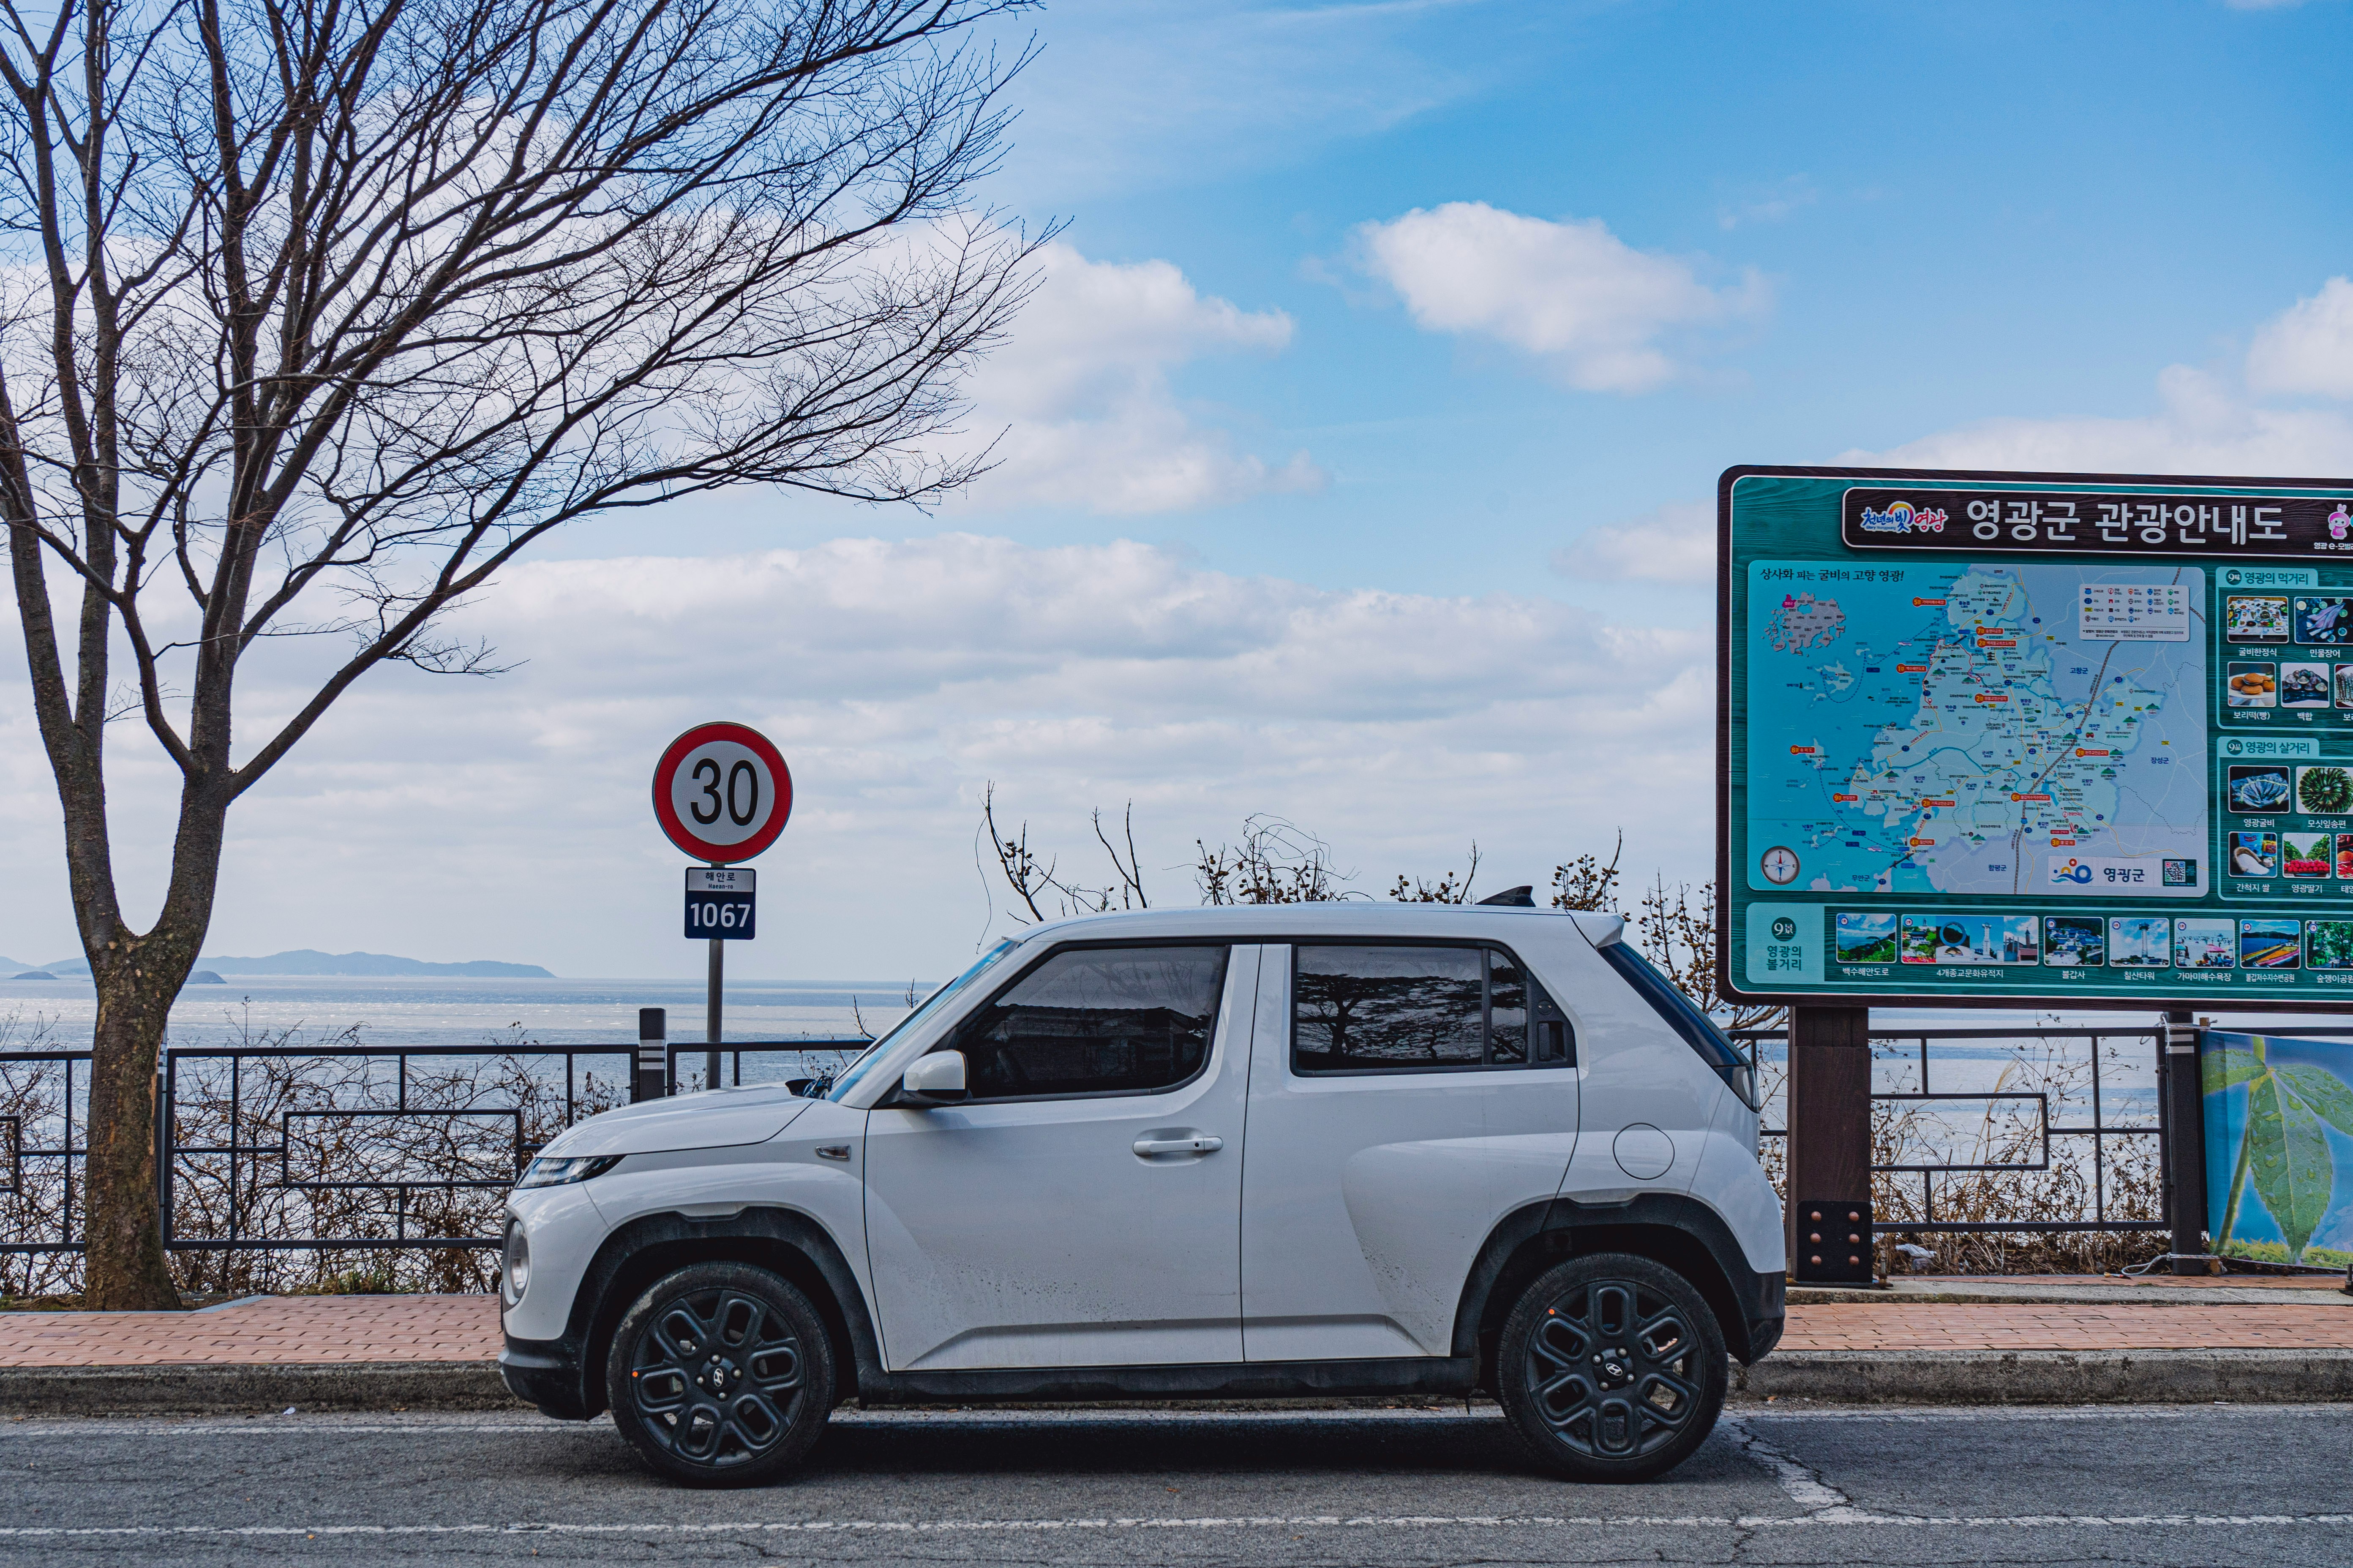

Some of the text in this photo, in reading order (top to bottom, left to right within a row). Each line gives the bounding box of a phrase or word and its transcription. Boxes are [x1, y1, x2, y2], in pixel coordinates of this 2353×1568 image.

[1862, 509, 1947, 531] 천년의 빛 영광
[1967, 501, 2287, 545] 영광군 관광안내도
[1760, 568, 1904, 582] 상사화 피는 굴비의 고향 영광!
[2244, 572, 2309, 585] 영광의 먹거리
[2238, 648, 2277, 657] 굴비한정식
[2309, 649, 2340, 658] 민물장어
[2233, 711, 2271, 720] 보리떡(빵)
[2297, 712, 2313, 721] 백합
[2246, 741, 2310, 754] 영광의 살거리
[690, 758, 758, 826] 30
[2244, 818, 2275, 828] 영광굴비
[2307, 819, 2346, 829] 모싯잎송편
[705, 871, 736, 882] 해안로
[2104, 868, 2145, 882] 영광군
[2236, 883, 2270, 892] 간척지 쌀
[2291, 884, 2323, 893] 영광딸기
[690, 903, 751, 928] 1067
[1767, 945, 1802, 958] 영광의
[1767, 958, 1802, 971] 볼거리
[1843, 967, 1889, 976] 백수해안도로
[1936, 969, 2004, 978] 4개종교문화유적지
[2062, 970, 2085, 979] 불갑사
[2124, 971, 2155, 981] 칠산타워
[2177, 973, 2232, 982] 가마미해수욕장
[2246, 973, 2295, 983] 불갑저수지수변공원
[2316, 974, 2353, 983] 숲쟁이공원
